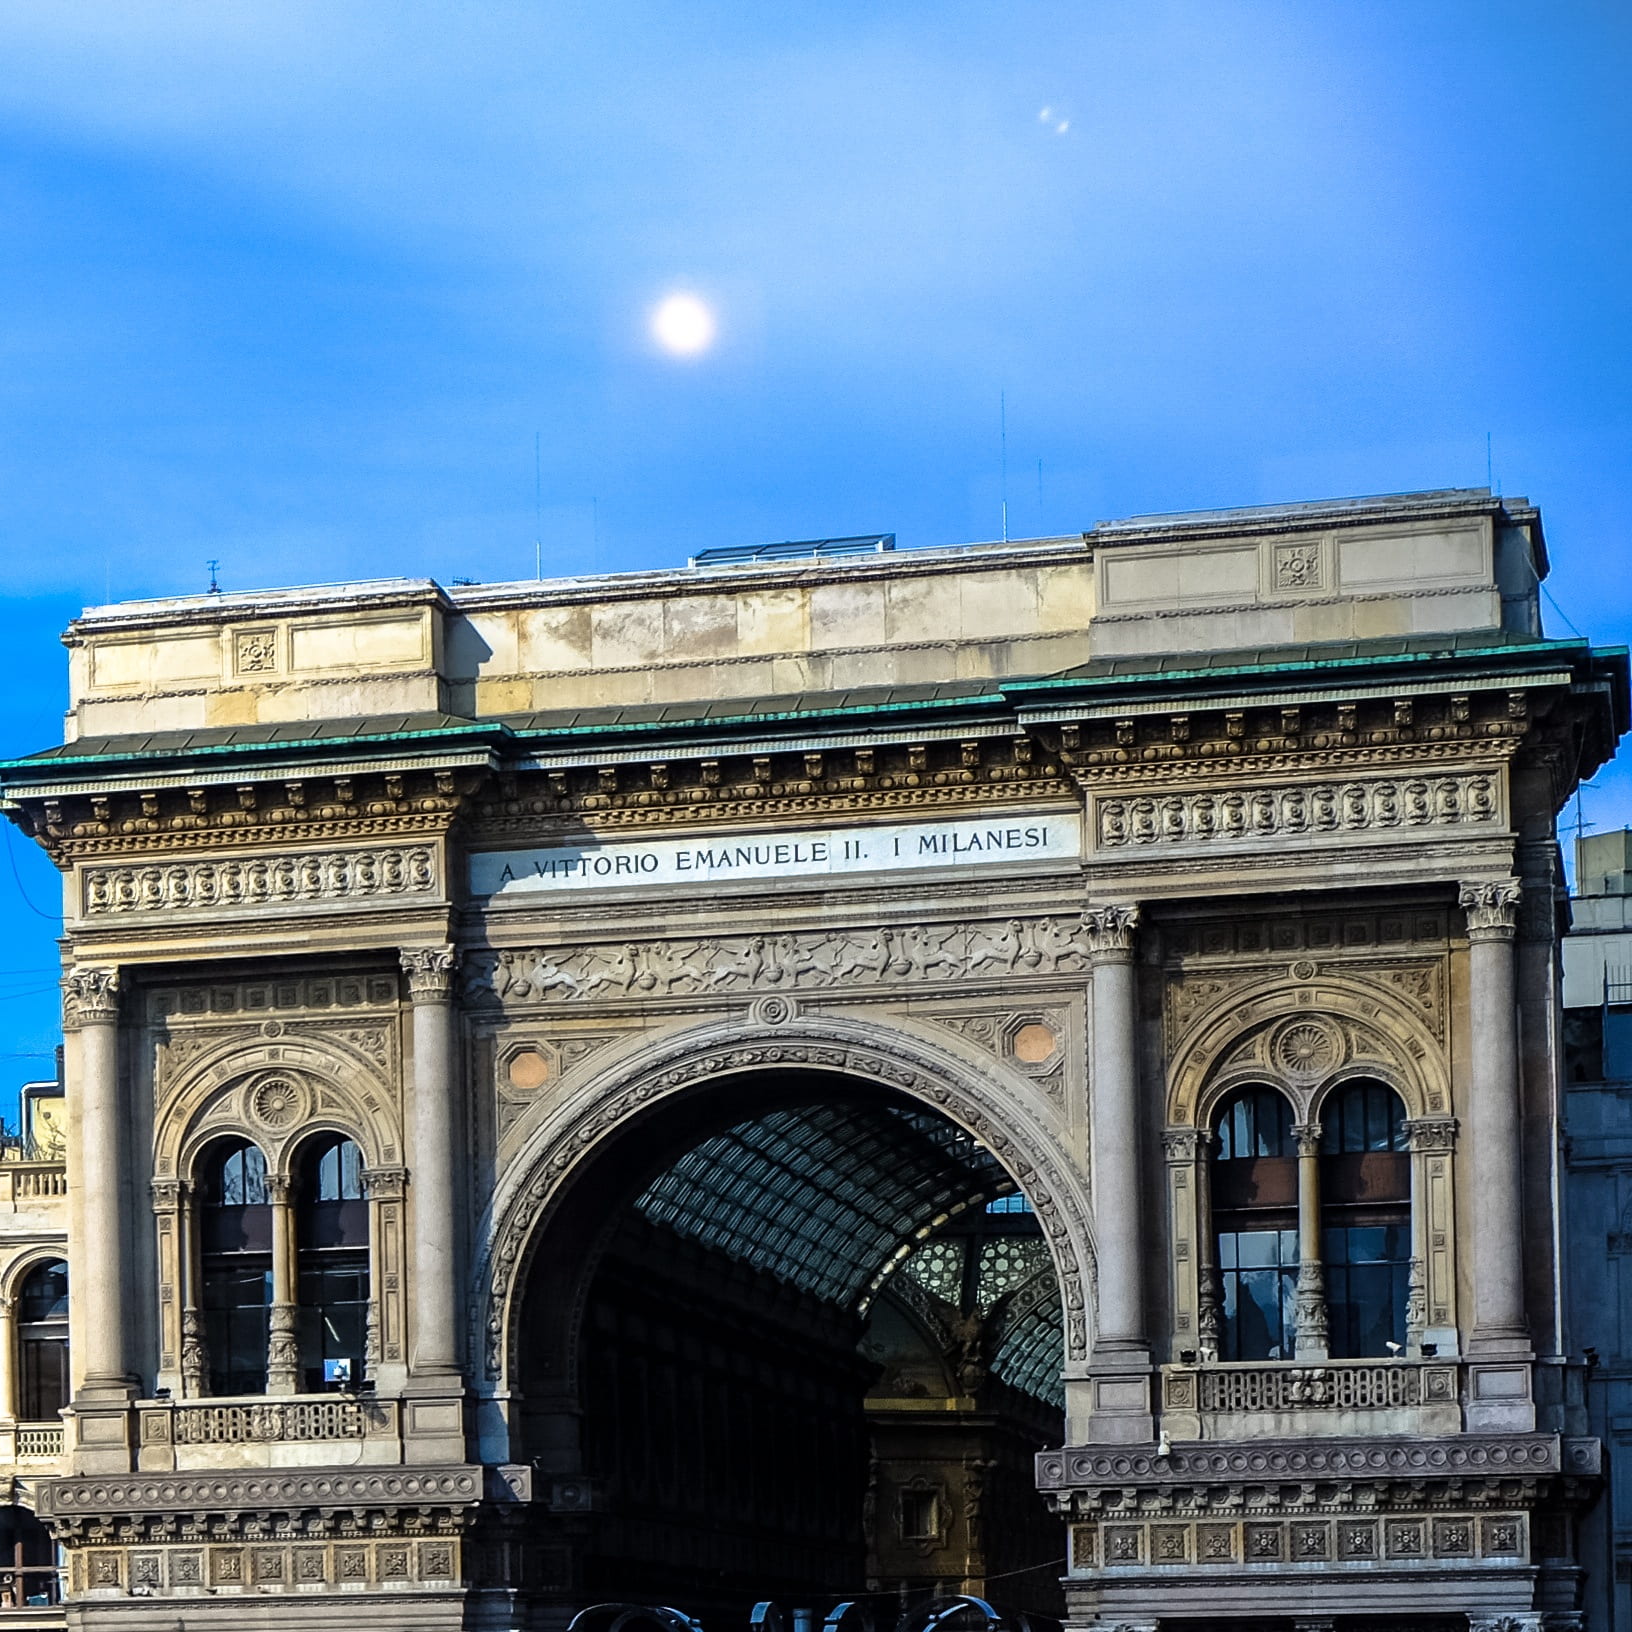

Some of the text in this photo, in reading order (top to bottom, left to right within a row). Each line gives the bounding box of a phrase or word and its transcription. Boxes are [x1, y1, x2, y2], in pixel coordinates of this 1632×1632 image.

[499, 863, 514, 881] A
[534, 853, 659, 879] VITTORIO
[676, 843, 829, 871] EMANUELE
[894, 837, 900, 856] I
[918, 827, 1049, 854] MILANESI
